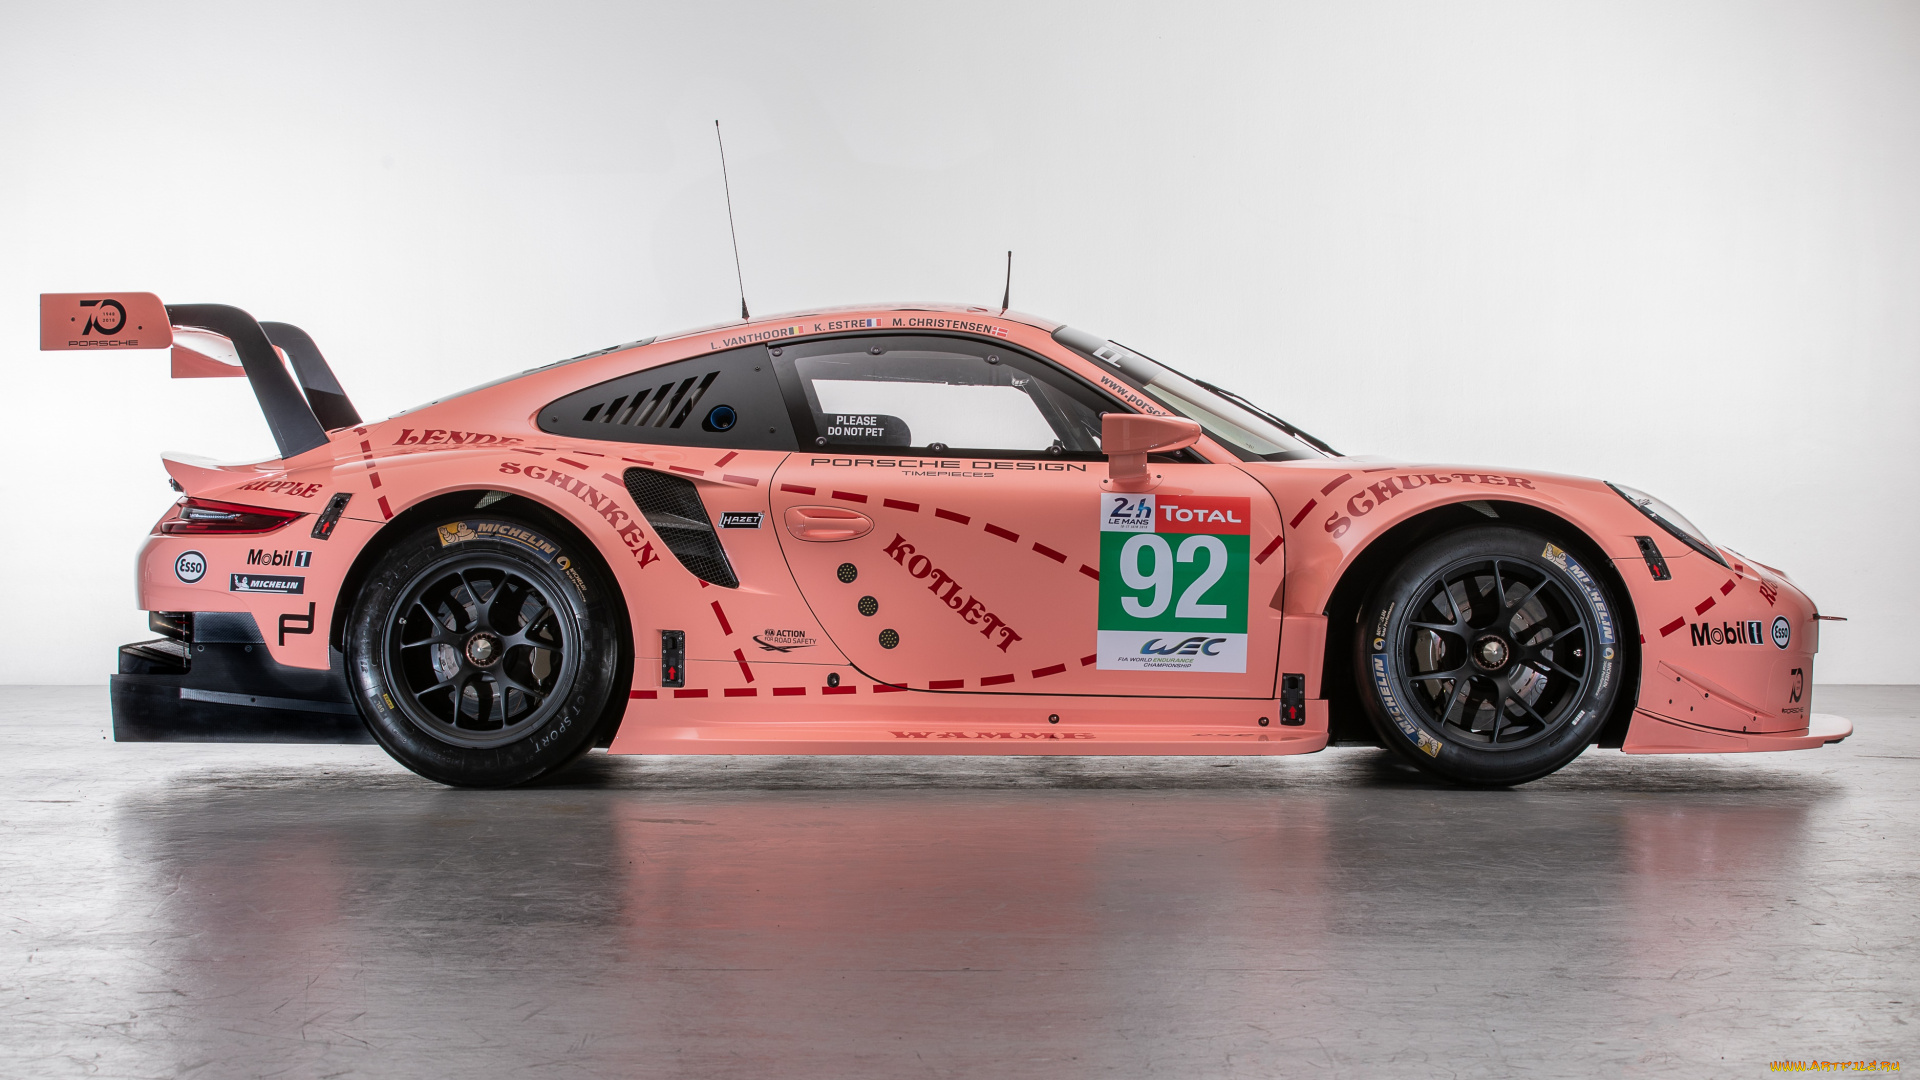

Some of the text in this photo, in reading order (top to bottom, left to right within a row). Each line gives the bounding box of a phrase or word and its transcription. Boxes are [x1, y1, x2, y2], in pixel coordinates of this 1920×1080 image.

[80, 299, 127, 335] 70
[814, 319, 866, 332] K. ESTRE
[892, 318, 993, 334] M. CHRISTENSEN
[710, 328, 788, 350] L. VANTHOOR
[836, 415, 877, 427] PLEASE
[827, 426, 884, 437] DO NOT PET
[811, 458, 1087, 473] PORSCHE DESIGN
[901, 470, 995, 478] TIMEPIECES
[237, 480, 323, 499] RIPPLE
[1110, 497, 1152, 519] 24h
[1160, 505, 1242, 523] TOTAL
[1324, 473, 1536, 539] SCHULTER
[498, 461, 660, 570] SCHINKEN
[723, 516, 760, 525] HAZET
[1121, 518, 1149, 526] MANS
[477, 523, 556, 554] MICHELIN
[247, 549, 293, 567] Mobil
[250, 580, 298, 590] MICHELIN
[1119, 533, 1228, 619] 92
[883, 533, 1022, 653] KOTLETT
[776, 629, 805, 638] ACTION
[1690, 621, 1748, 647] Mobil
[1140, 636, 1227, 656] WEC
[1374, 657, 1416, 735] MICHELIN
[535, 716, 572, 753] SPORT
[888, 731, 1097, 740] WAMME
